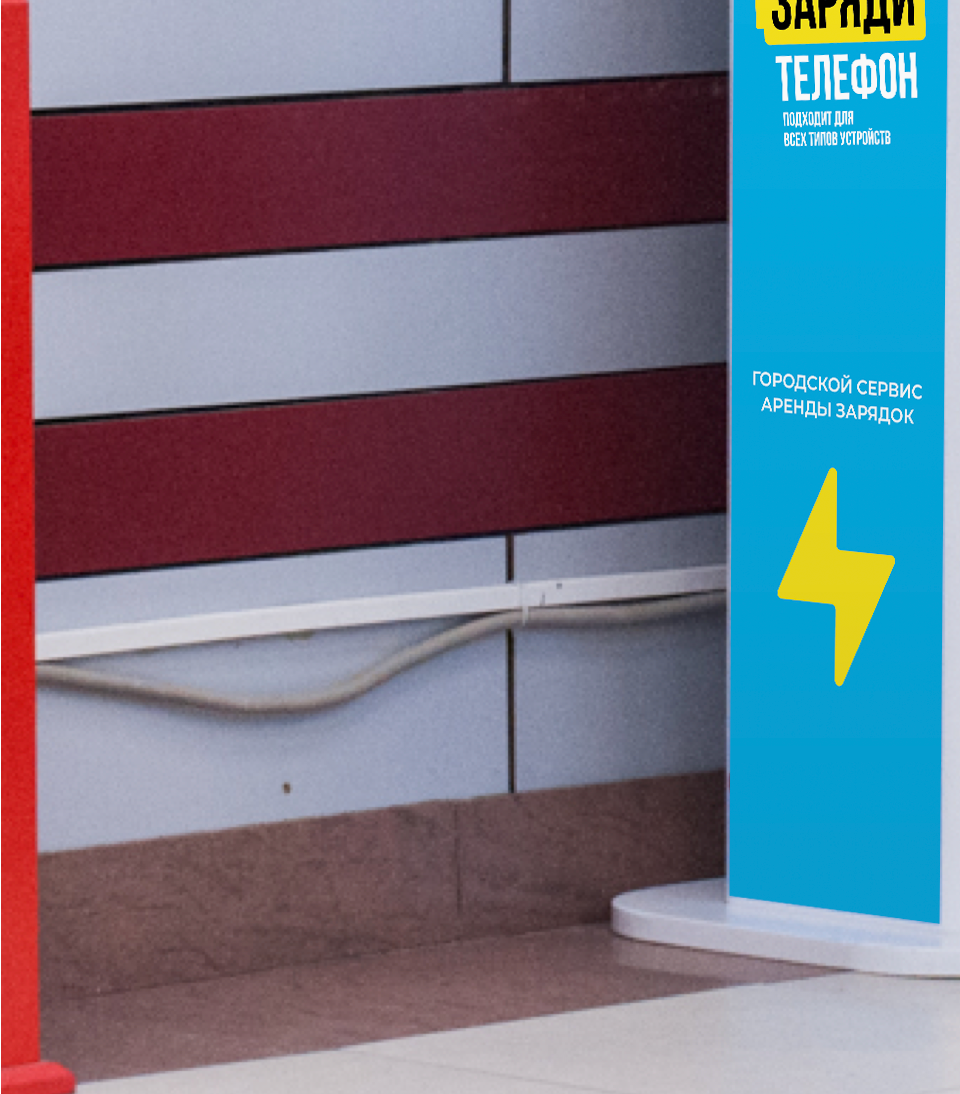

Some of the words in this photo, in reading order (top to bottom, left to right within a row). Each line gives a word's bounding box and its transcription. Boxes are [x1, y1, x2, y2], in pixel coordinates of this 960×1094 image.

[775, 52, 918, 101] ТЕЛЕФОН
[783, 111, 832, 128] ПОДХОДИТ
[834, 110, 854, 127] ДЛЯ
[783, 132, 807, 147] ВСЕХ
[808, 131, 838, 146] ТИПОВ
[839, 128, 891, 146] УСТРОЙСТВ
[753, 371, 852, 394] ГОРОДСКОЙ
[856, 380, 923, 400] СЕРВИС
[761, 397, 831, 419] АРЕНДЫ
[836, 403, 914, 425] ЗАРЯДОК
